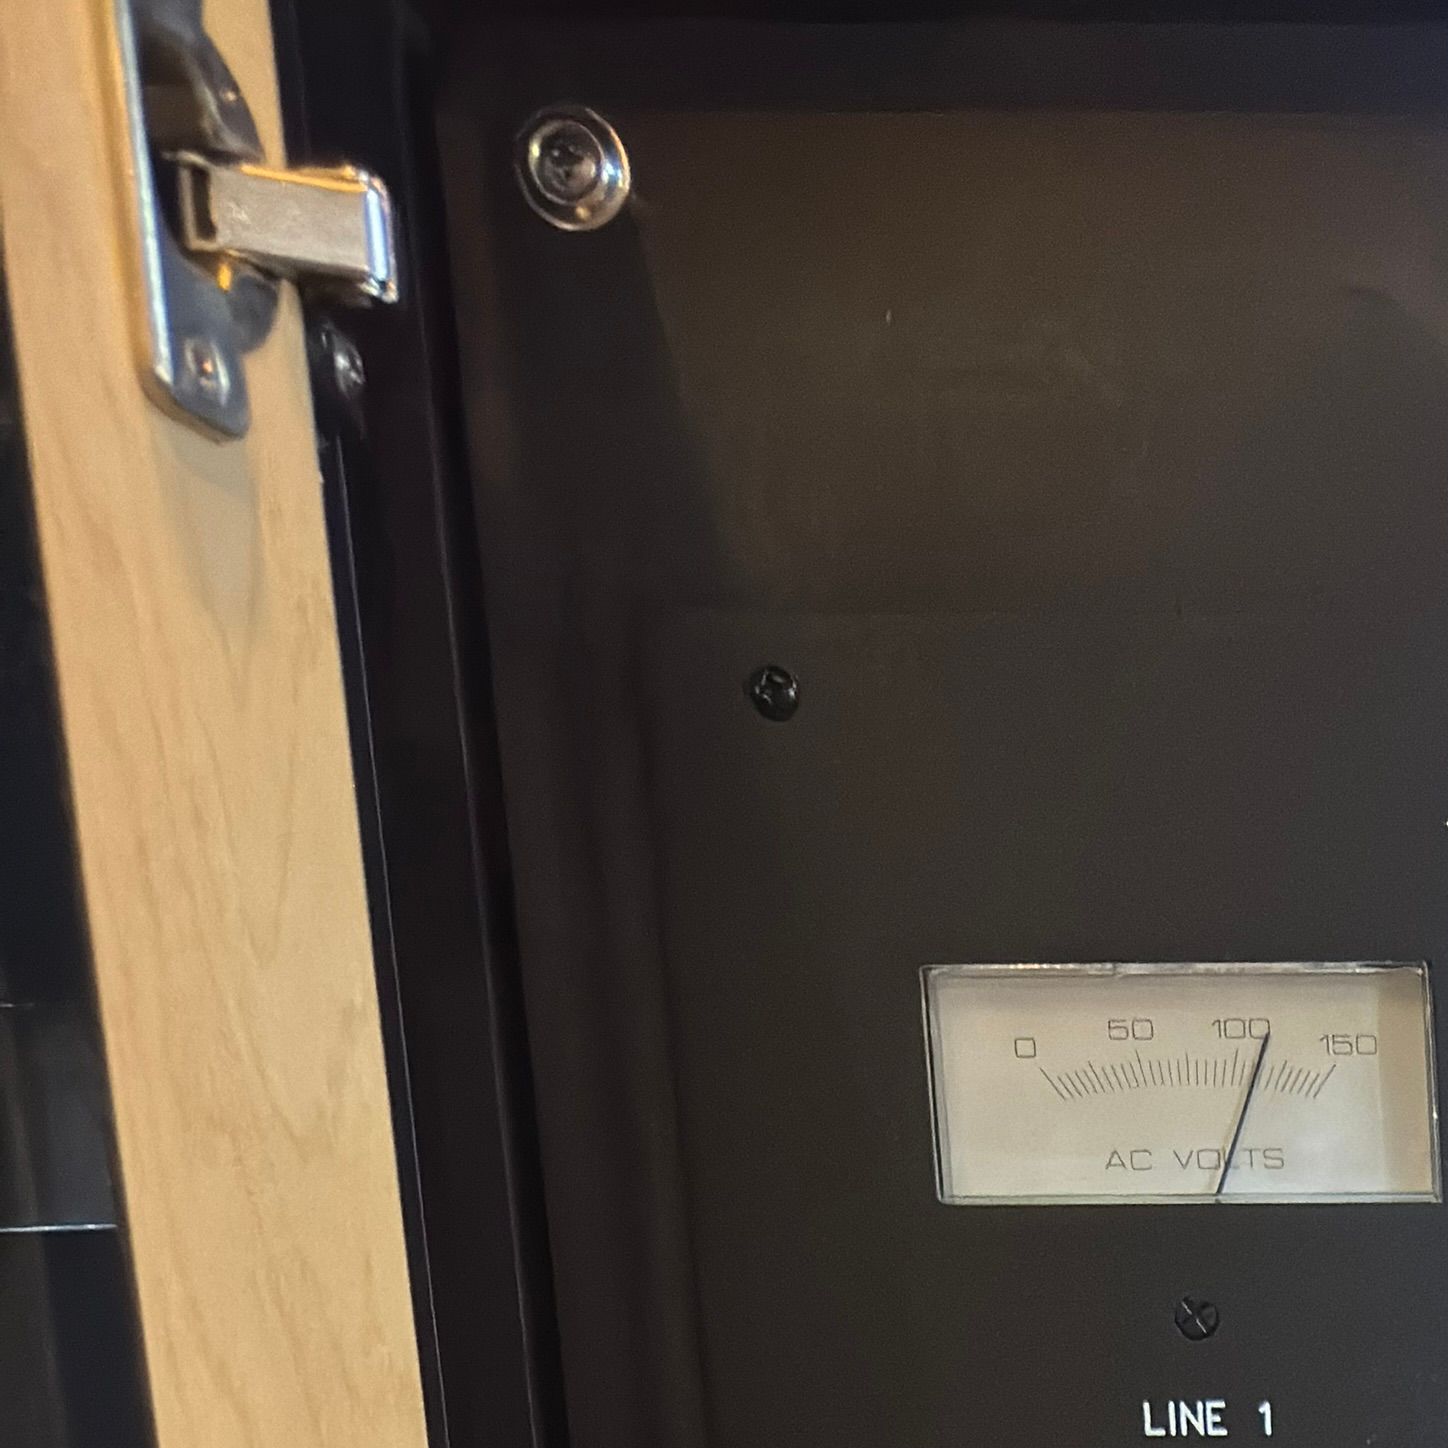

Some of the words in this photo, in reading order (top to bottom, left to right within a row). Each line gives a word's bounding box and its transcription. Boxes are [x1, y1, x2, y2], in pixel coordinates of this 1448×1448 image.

[1108, 1019, 1154, 1040] 50
[1211, 1018, 1270, 1039] 100
[1319, 1034, 1377, 1055] 150
[1105, 1148, 1154, 1171] AC
[1172, 1148, 1285, 1170] VOLTS
[1143, 1400, 1227, 1436] LINE
[1259, 1402, 1271, 1435] 1
